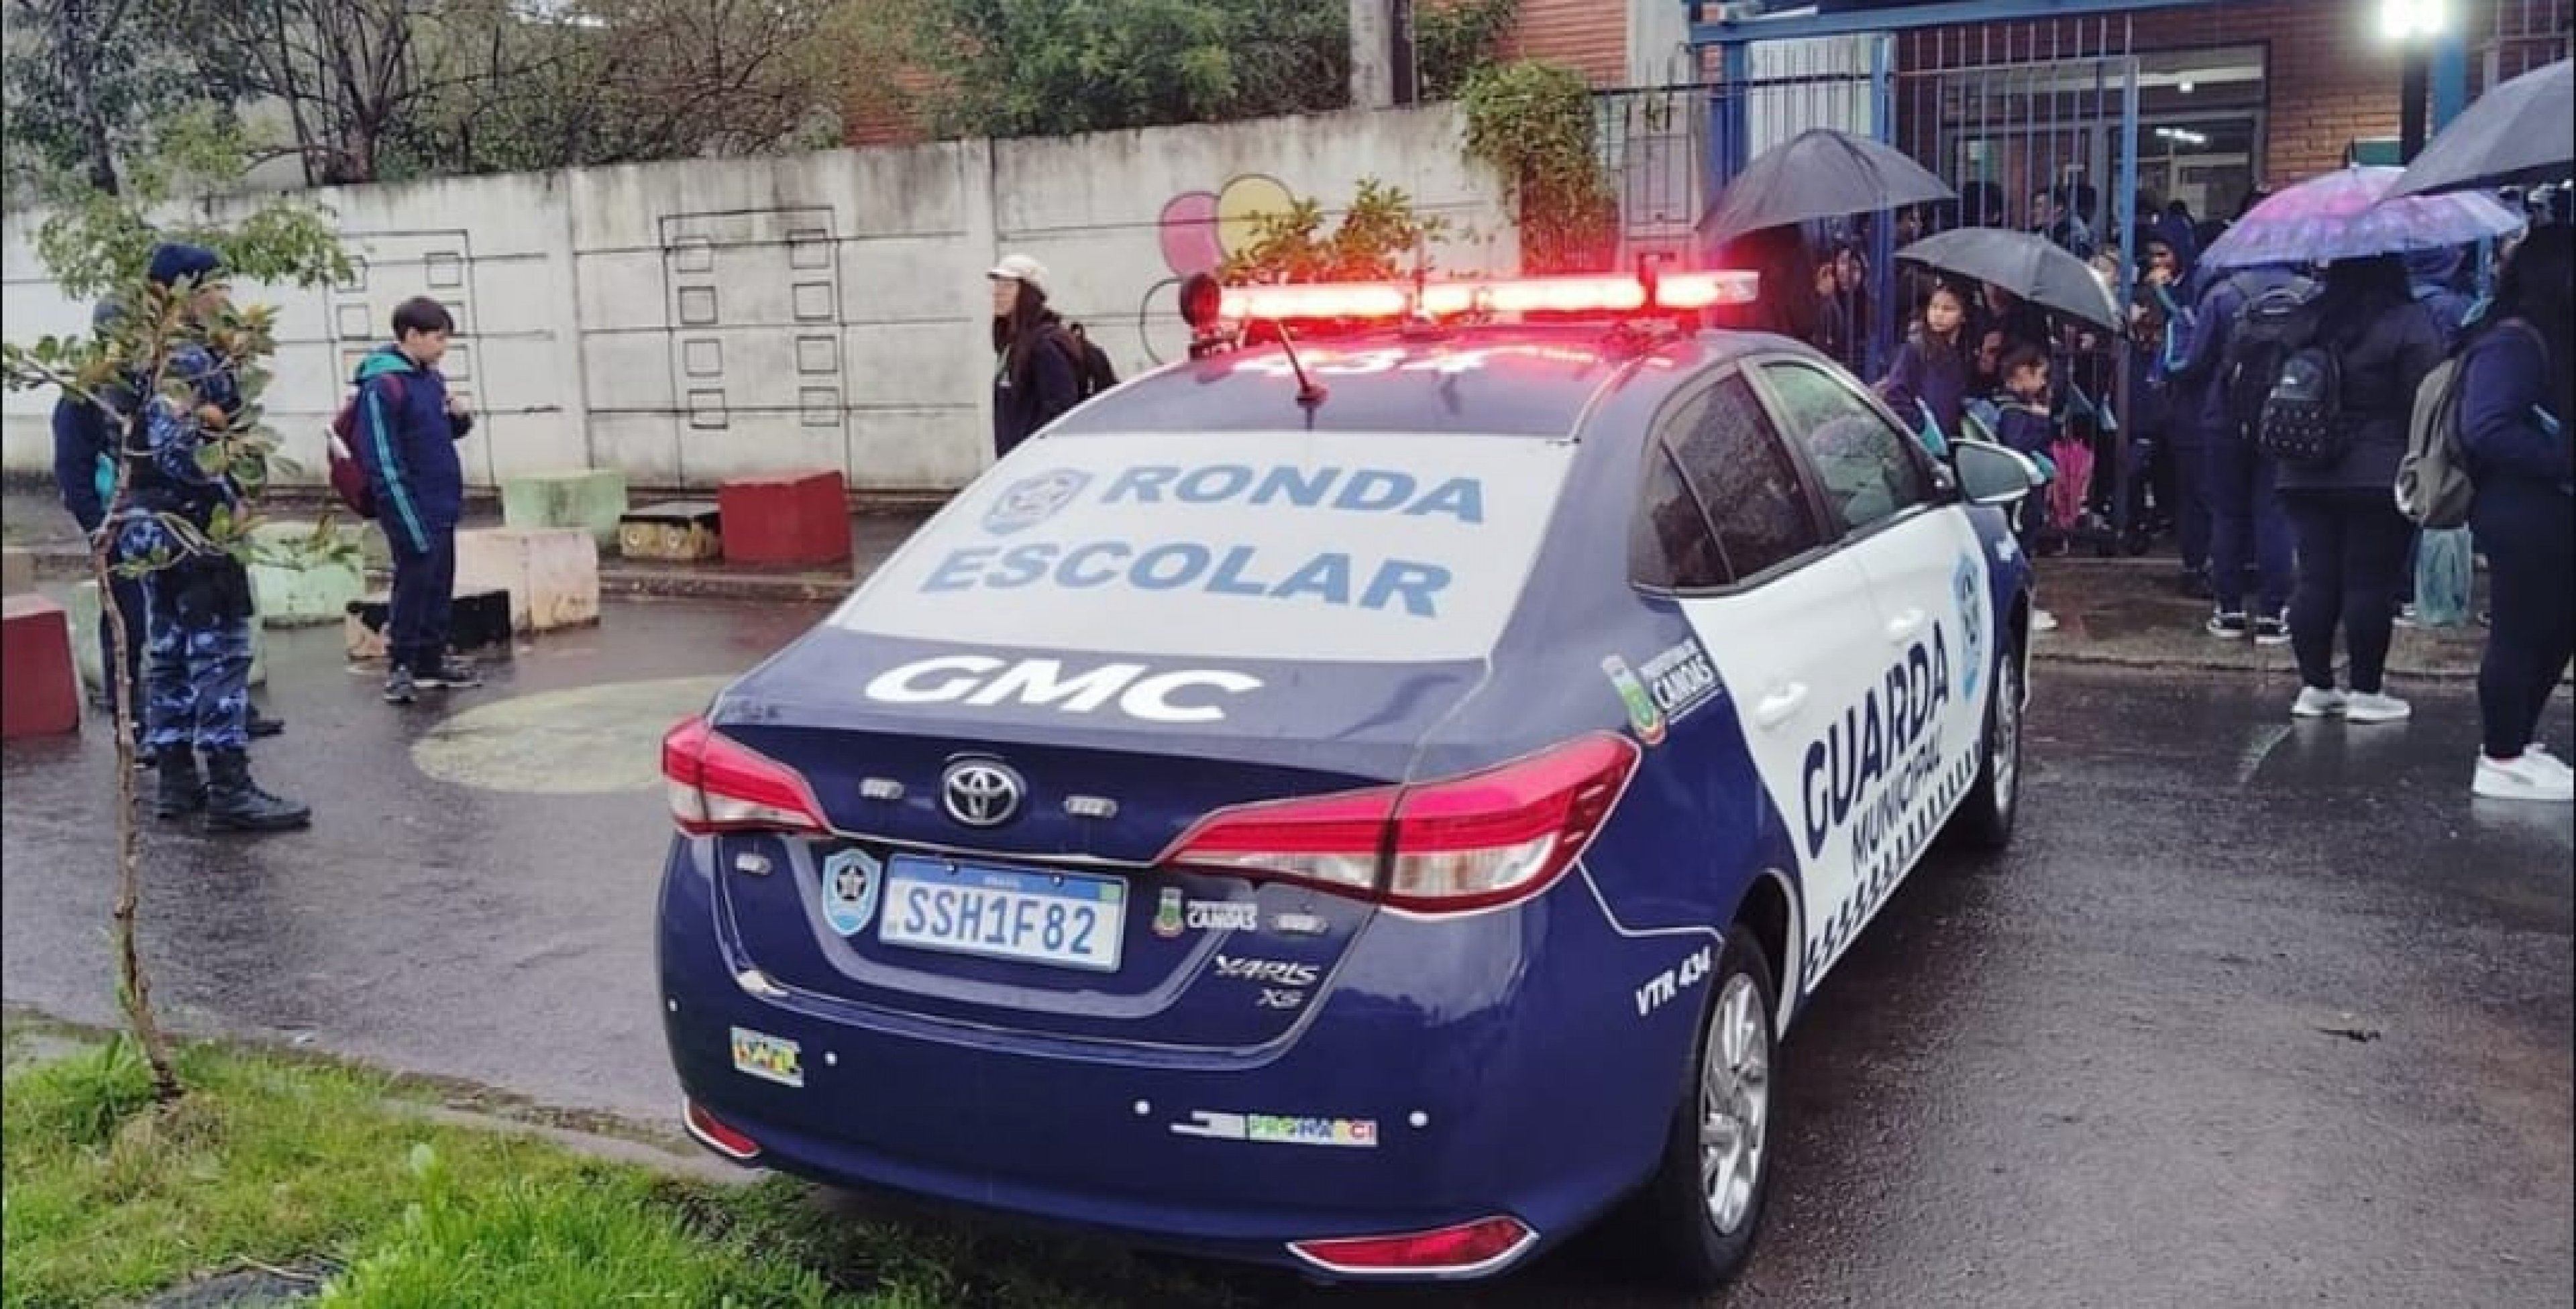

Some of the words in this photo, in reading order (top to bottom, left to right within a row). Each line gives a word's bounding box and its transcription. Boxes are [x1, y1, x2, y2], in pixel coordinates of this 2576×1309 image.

[1100, 465, 1485, 523] RONDA
[919, 540, 1453, 617] ESCOLAR
[864, 654, 1265, 722] GMC
[1803, 618, 1949, 860] GUARDA
[1851, 722, 1944, 880] MUNICIPAL
[904, 886, 1097, 955] SSH1F82
[1215, 955, 1321, 986] YARIS
[1255, 988, 1303, 1009] XS
[1635, 968, 1676, 1017] VTR
[1678, 945, 1711, 987] 434
